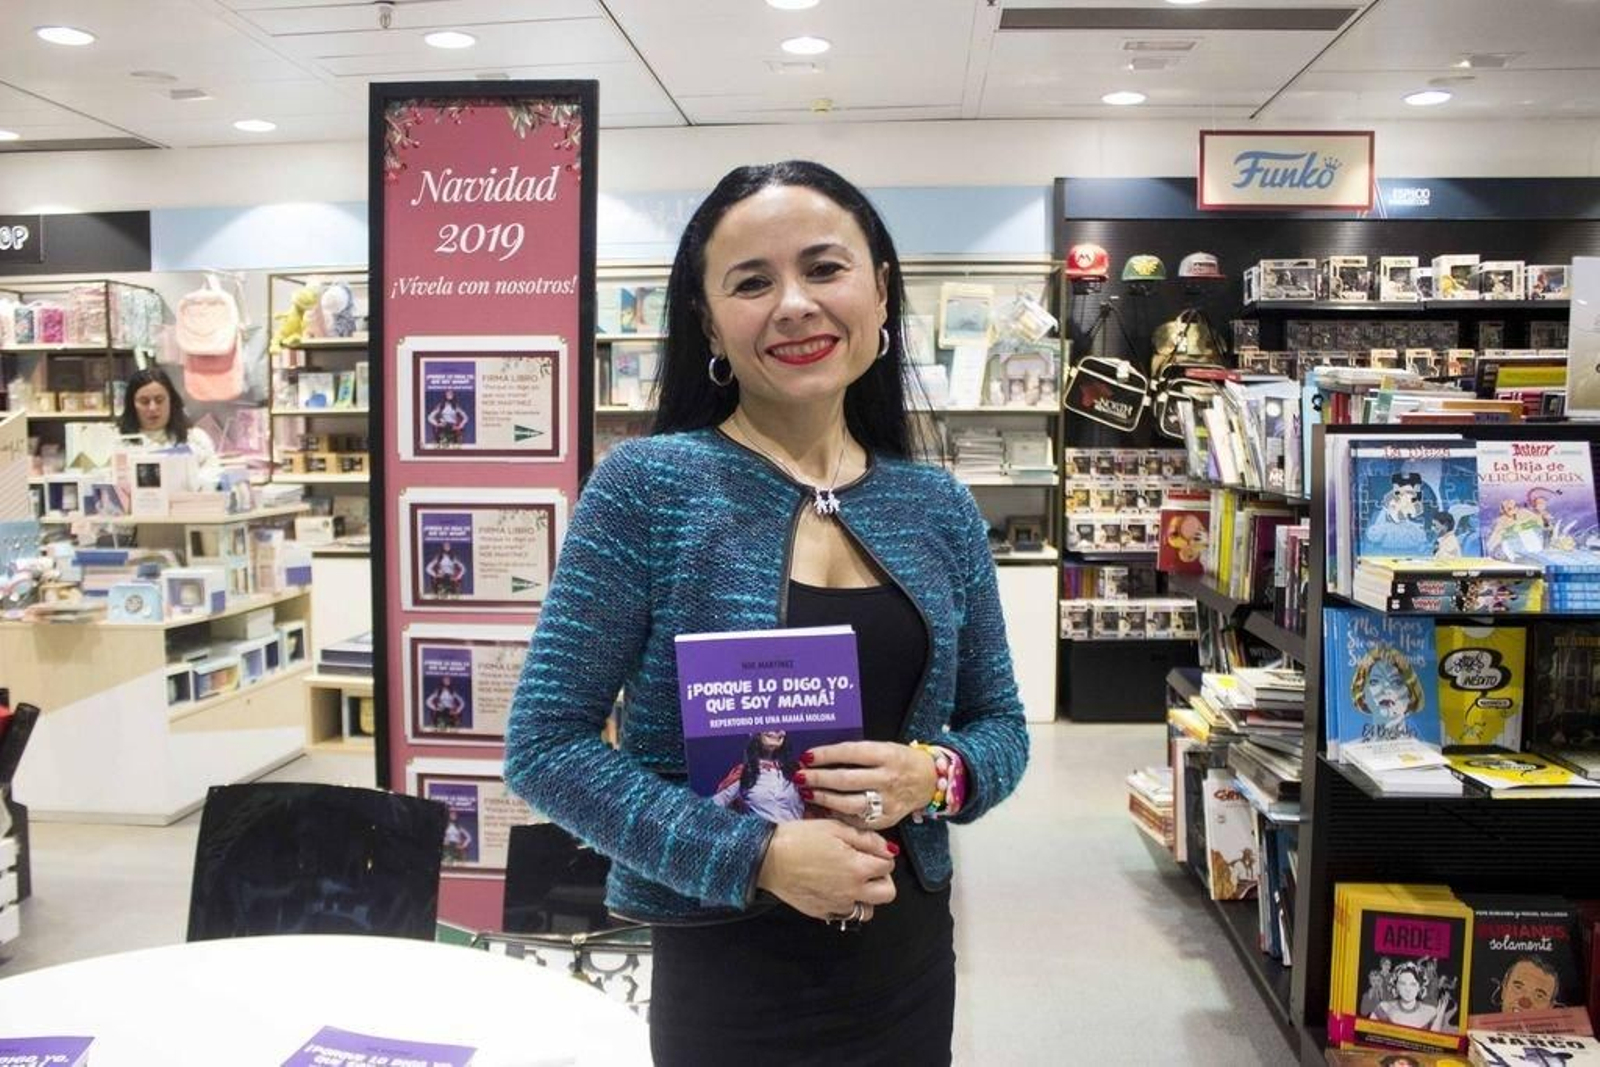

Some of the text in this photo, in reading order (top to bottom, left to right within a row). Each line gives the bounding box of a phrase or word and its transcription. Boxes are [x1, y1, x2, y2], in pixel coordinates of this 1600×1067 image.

[1232, 151, 1336, 189] Funko
[411, 166, 560, 206] Navidad
[435, 222, 524, 261] 2019
[391, 275, 577, 299] ¡Vívela con nosotros!
[1513, 458, 1542, 473] hija
[1546, 461, 1565, 471] de
[687, 680, 752, 700] ¡PORQUE
[758, 678, 777, 692] LO
[783, 677, 822, 690] DIGO
[706, 690, 835, 713] QUE SOY MAMÁ!
[710, 712, 836, 728] REPERTORIO DE UNA MAMÁ MOLONA
[1489, 935, 1552, 951] solamente
